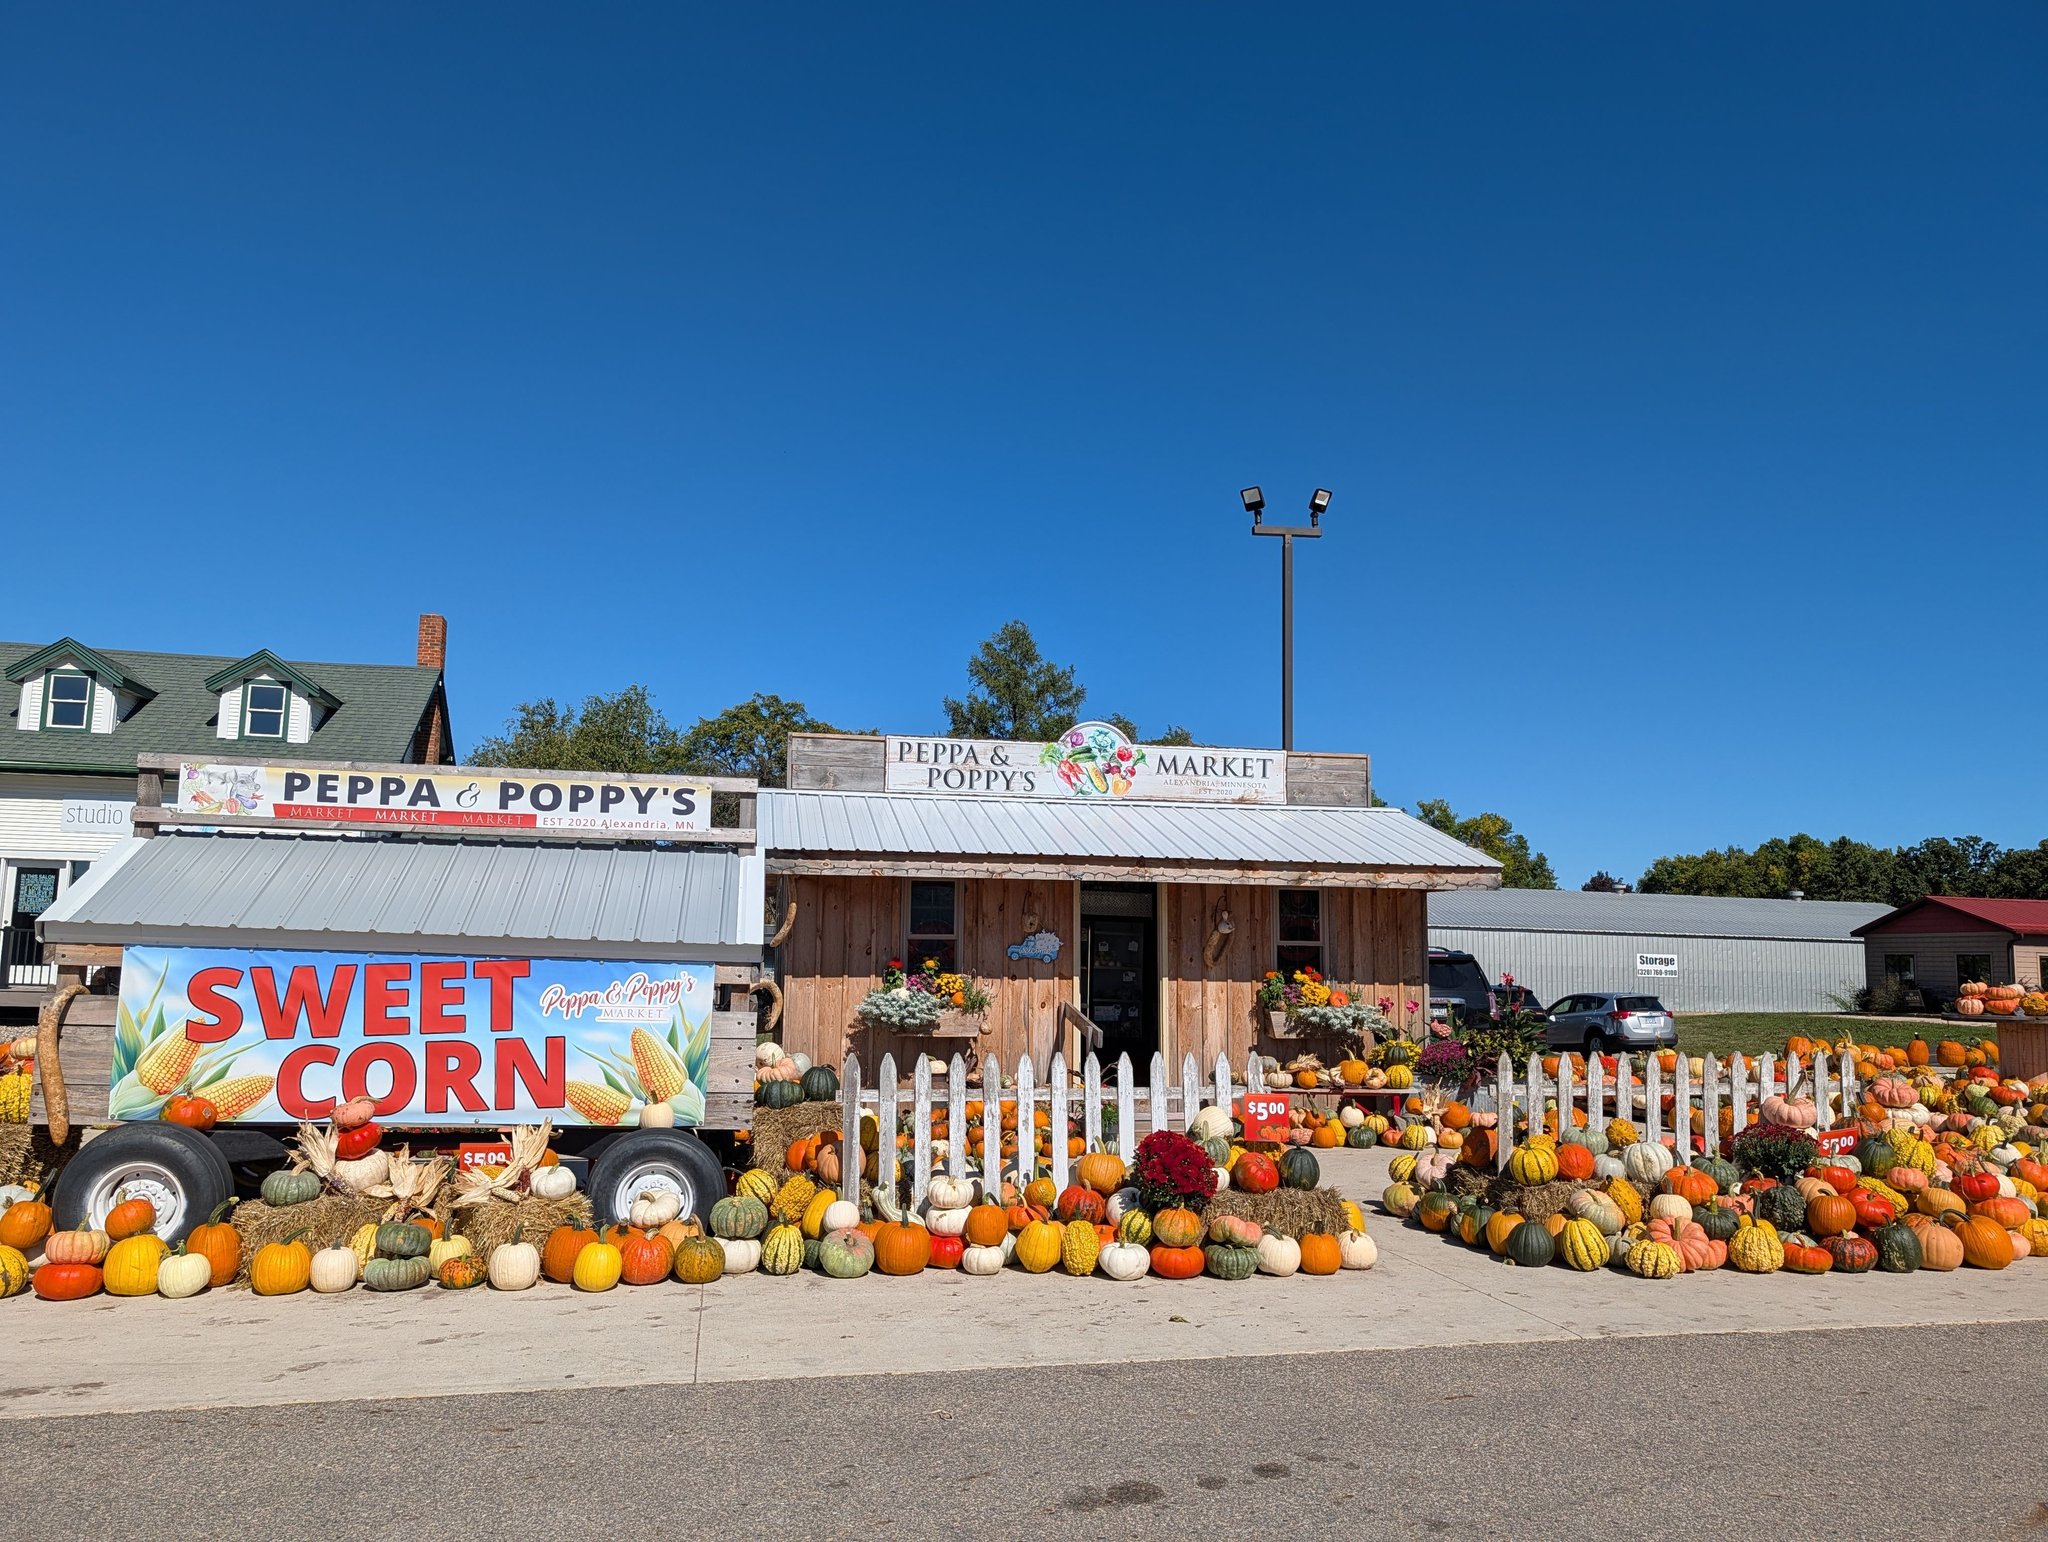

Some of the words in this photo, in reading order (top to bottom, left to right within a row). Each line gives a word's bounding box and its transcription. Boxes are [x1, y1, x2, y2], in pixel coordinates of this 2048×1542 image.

[898, 741, 981, 765] PEPPA
[990, 745, 1011, 767] &
[1155, 754, 1274, 779] MARKET
[927, 767, 1037, 792] POPPY'S
[1163, 779, 1218, 788] ALEXANDRIA,
[1221, 781, 1267, 789] MINNESOTA
[284, 772, 441, 808] PEPPA
[456, 782, 481, 808] &
[498, 781, 696, 816] POPPY'S
[66, 804, 123, 825] studio
[290, 806, 354, 819] MARKET
[375, 810, 438, 822] MARKET
[462, 813, 524, 825] MARKET
[543, 817, 563, 827] EST
[568, 818, 596, 828] 2020
[600, 819, 670, 830] Alexandria,
[675, 821, 695, 830] MN
[1639, 955, 1675, 966] Storage
[185, 960, 531, 1044] SWEET
[541, 986, 600, 1018] Peppa
[606, 983, 622, 1005] &
[626, 973, 695, 1005] Poppy's
[603, 1008, 664, 1018] MARKET
[276, 1036, 566, 1120] CORN
